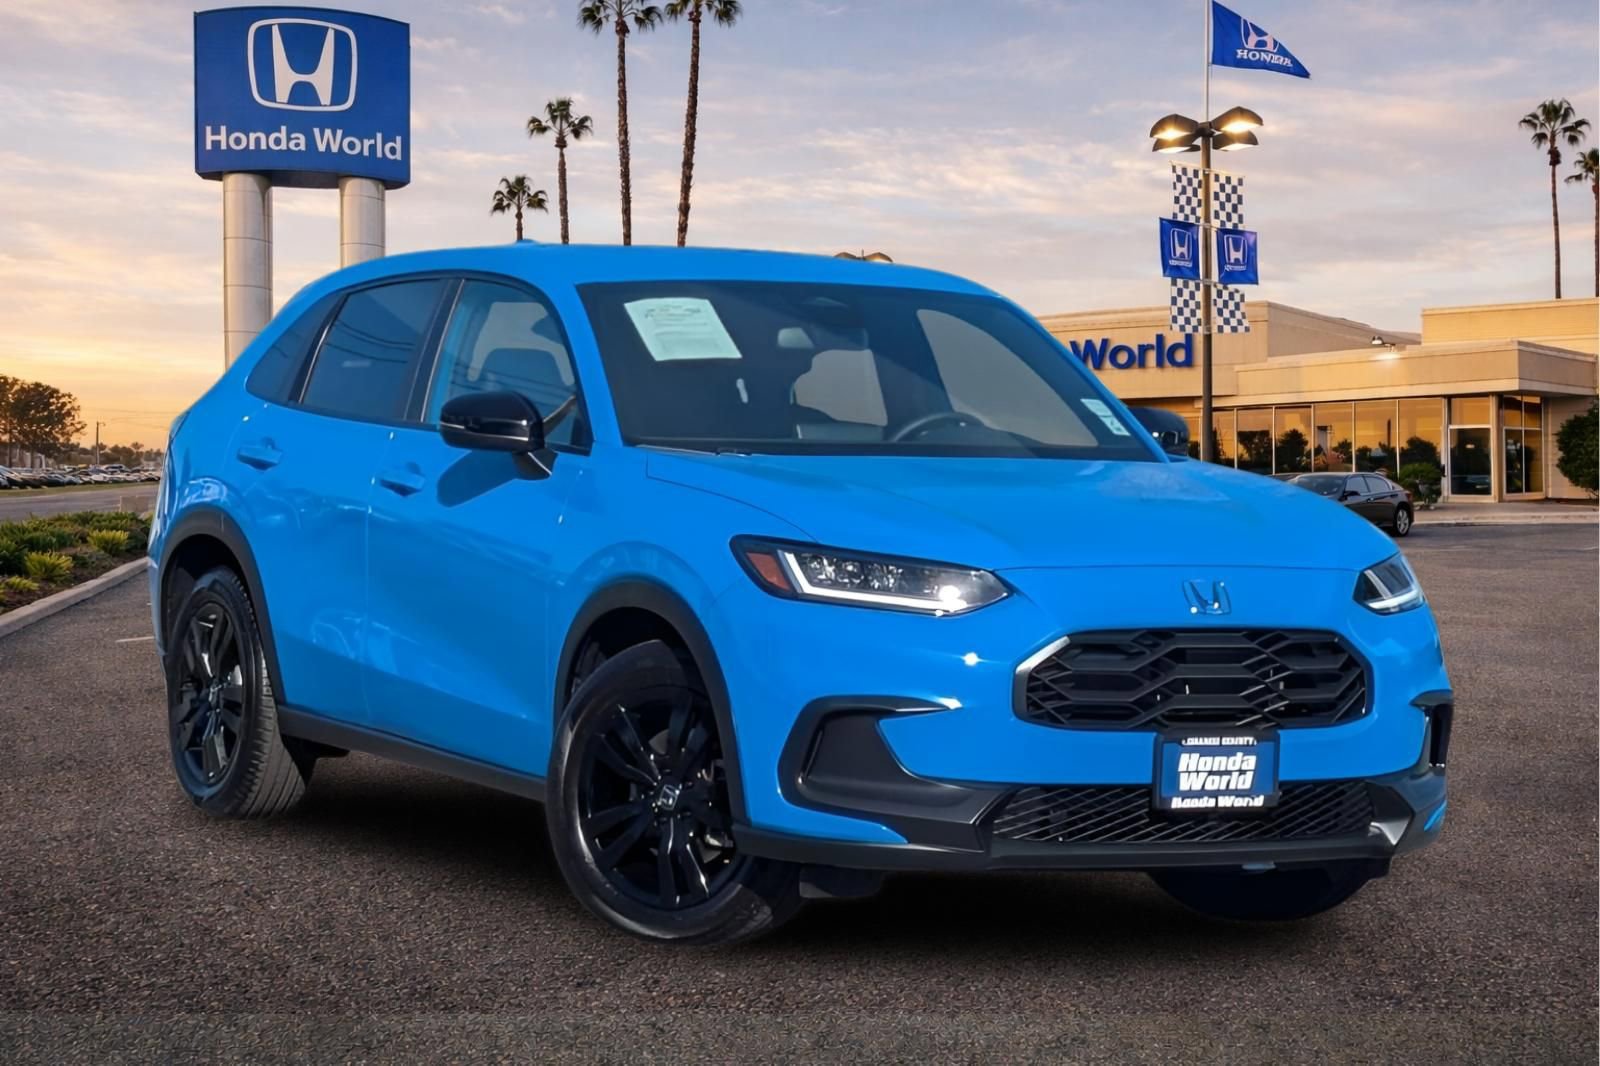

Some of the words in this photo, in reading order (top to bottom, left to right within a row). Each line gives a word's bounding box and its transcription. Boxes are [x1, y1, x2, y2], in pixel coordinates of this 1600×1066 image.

[205, 125, 306, 151] Honda
[313, 127, 402, 161] World
[1069, 333, 1193, 370] World
[1178, 752, 1256, 772] Honda
[1179, 771, 1254, 791] World
